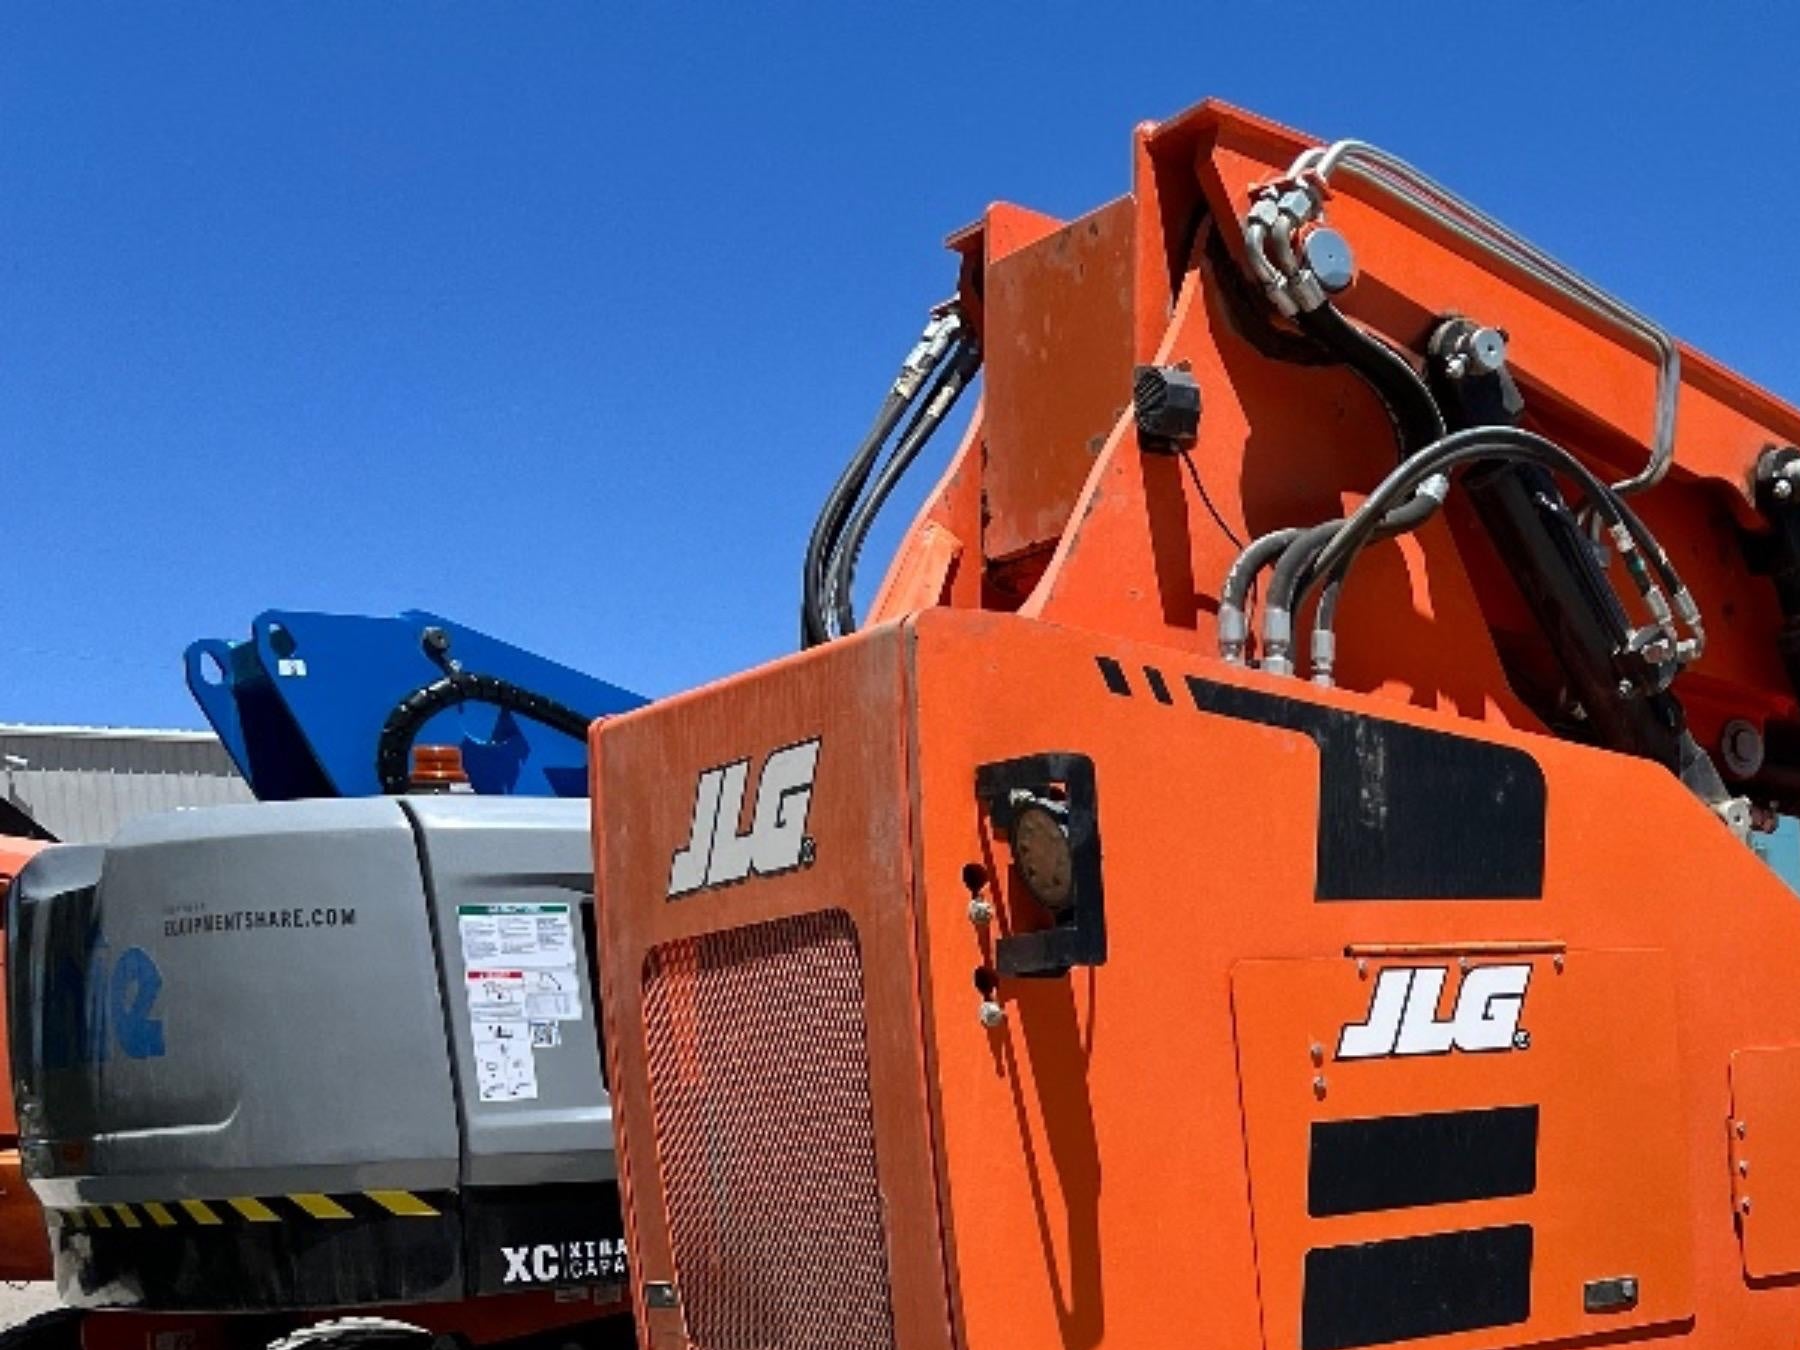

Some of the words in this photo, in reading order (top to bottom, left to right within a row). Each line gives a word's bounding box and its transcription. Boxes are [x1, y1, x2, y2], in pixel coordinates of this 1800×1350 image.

[666, 735, 821, 902] JLG
[164, 907, 356, 938] EQUIPMENTSHARE.COM
[1333, 962, 1533, 1062] JLG
[500, 1243, 559, 1284] XC
[568, 1238, 628, 1259] XTRA
[568, 1256, 626, 1280] CAPA
